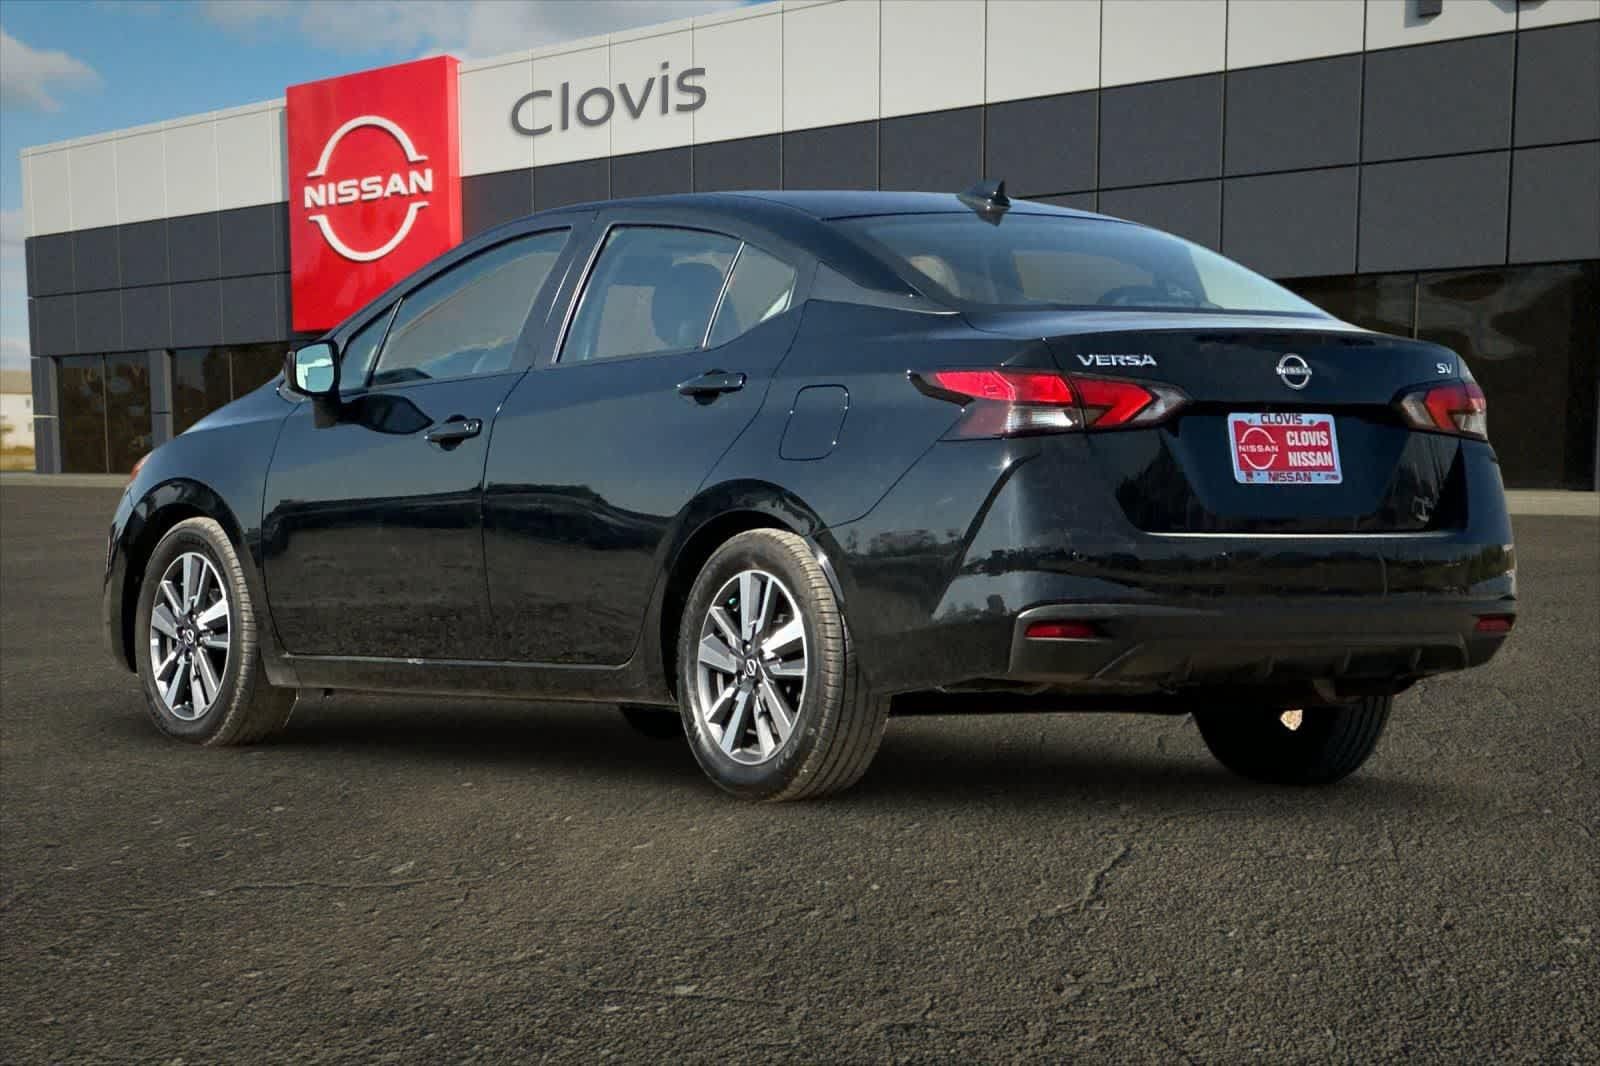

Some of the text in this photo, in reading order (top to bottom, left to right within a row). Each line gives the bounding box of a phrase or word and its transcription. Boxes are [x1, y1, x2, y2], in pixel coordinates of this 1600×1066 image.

[511, 61, 707, 136] Clovis
[304, 168, 433, 208] NISSAN
[1076, 354, 1157, 367] VERSA
[1436, 363, 1452, 374] SV
[1260, 414, 1303, 424] CLOVIS
[1286, 431, 1328, 446] CLOVIS
[1238, 444, 1279, 453] NISSAN
[1288, 451, 1333, 467] NISSAN
[1268, 472, 1312, 482] NISSAN
